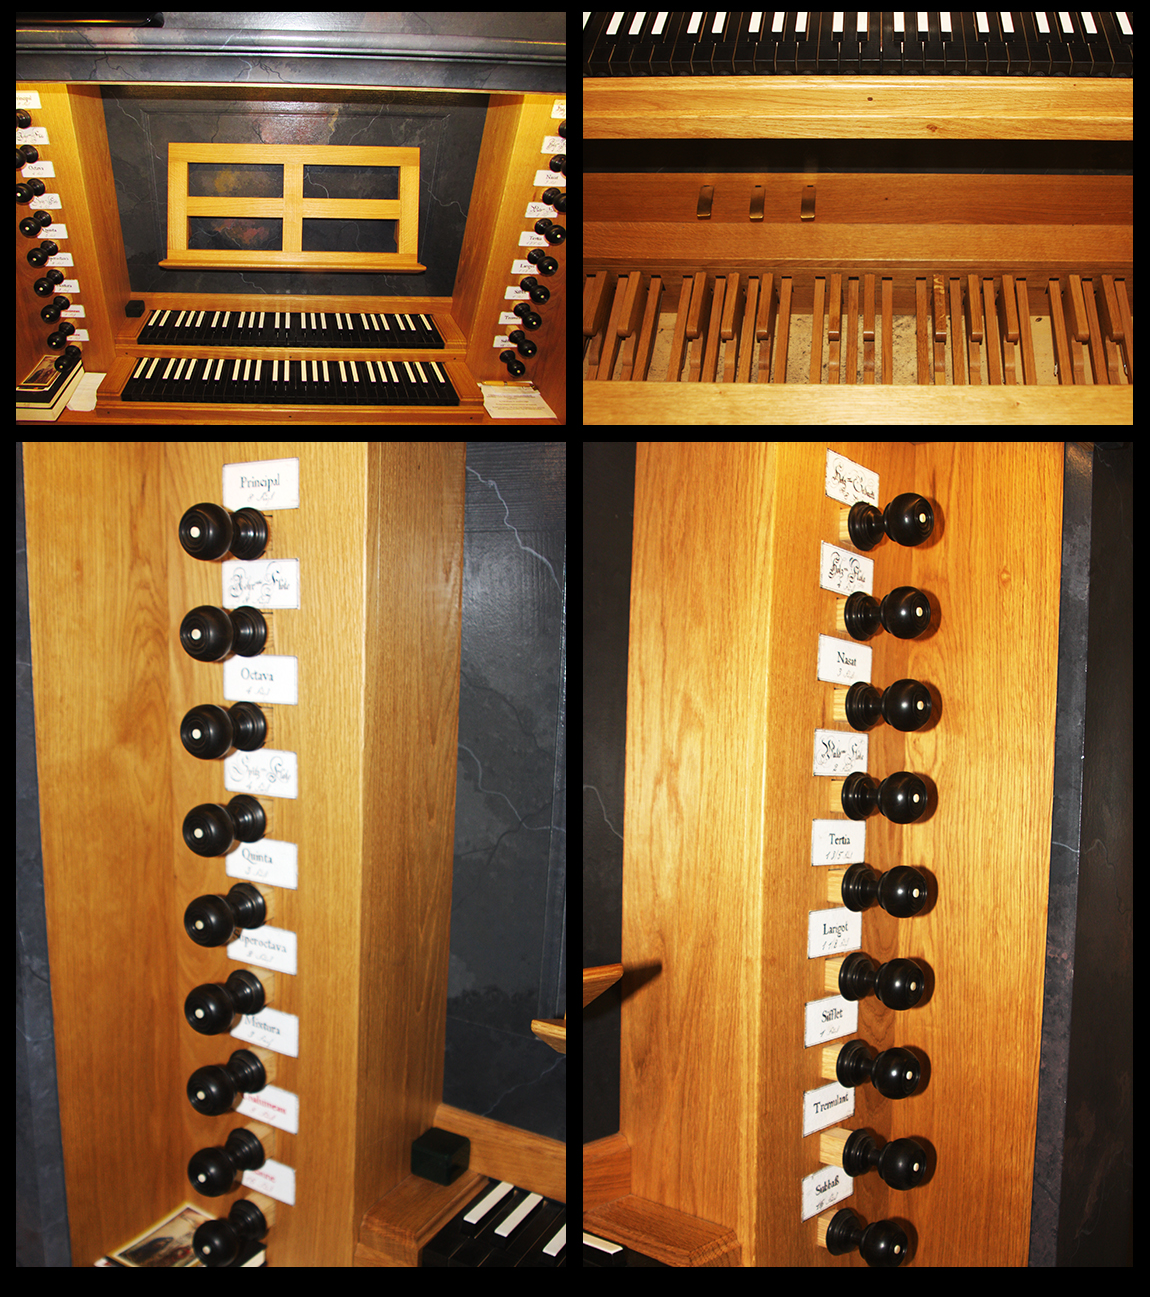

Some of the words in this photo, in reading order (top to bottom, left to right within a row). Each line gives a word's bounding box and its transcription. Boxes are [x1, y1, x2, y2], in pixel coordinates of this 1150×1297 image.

[240, 473, 280, 492] Principal
[241, 667, 274, 682] Octava
[829, 833, 851, 845] Tertia
[241, 847, 273, 865] Quinta
[244, 1015, 281, 1035] Mixtura
